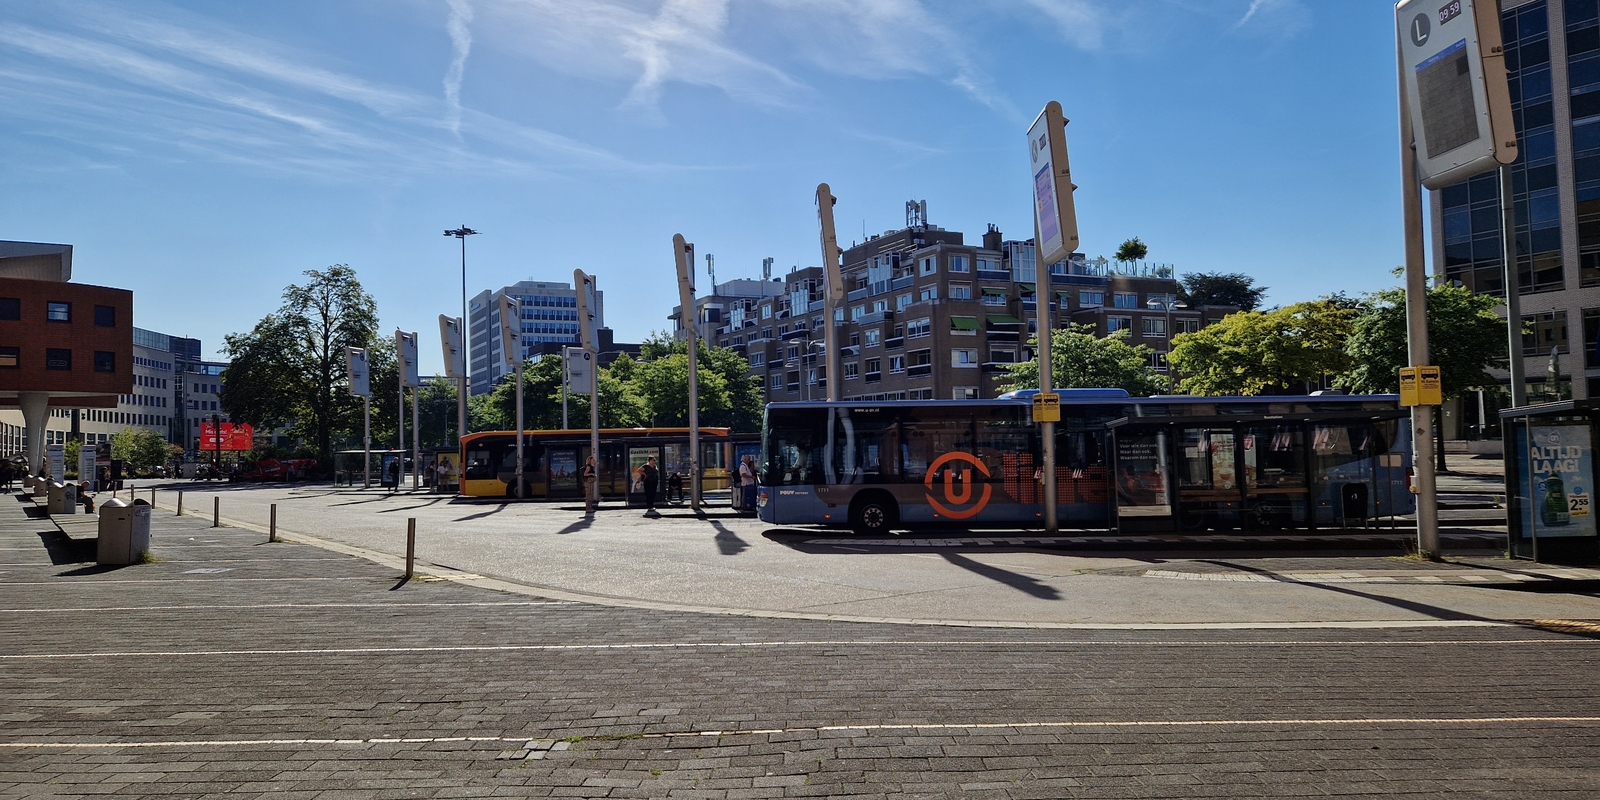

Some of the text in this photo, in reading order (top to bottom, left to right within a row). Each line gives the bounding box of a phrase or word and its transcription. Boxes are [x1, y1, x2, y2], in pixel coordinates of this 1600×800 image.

[1415, 19, 1427, 41] L
[1531, 446, 1581, 460] ALTIJD
[1533, 460, 1579, 473] LAAG!
